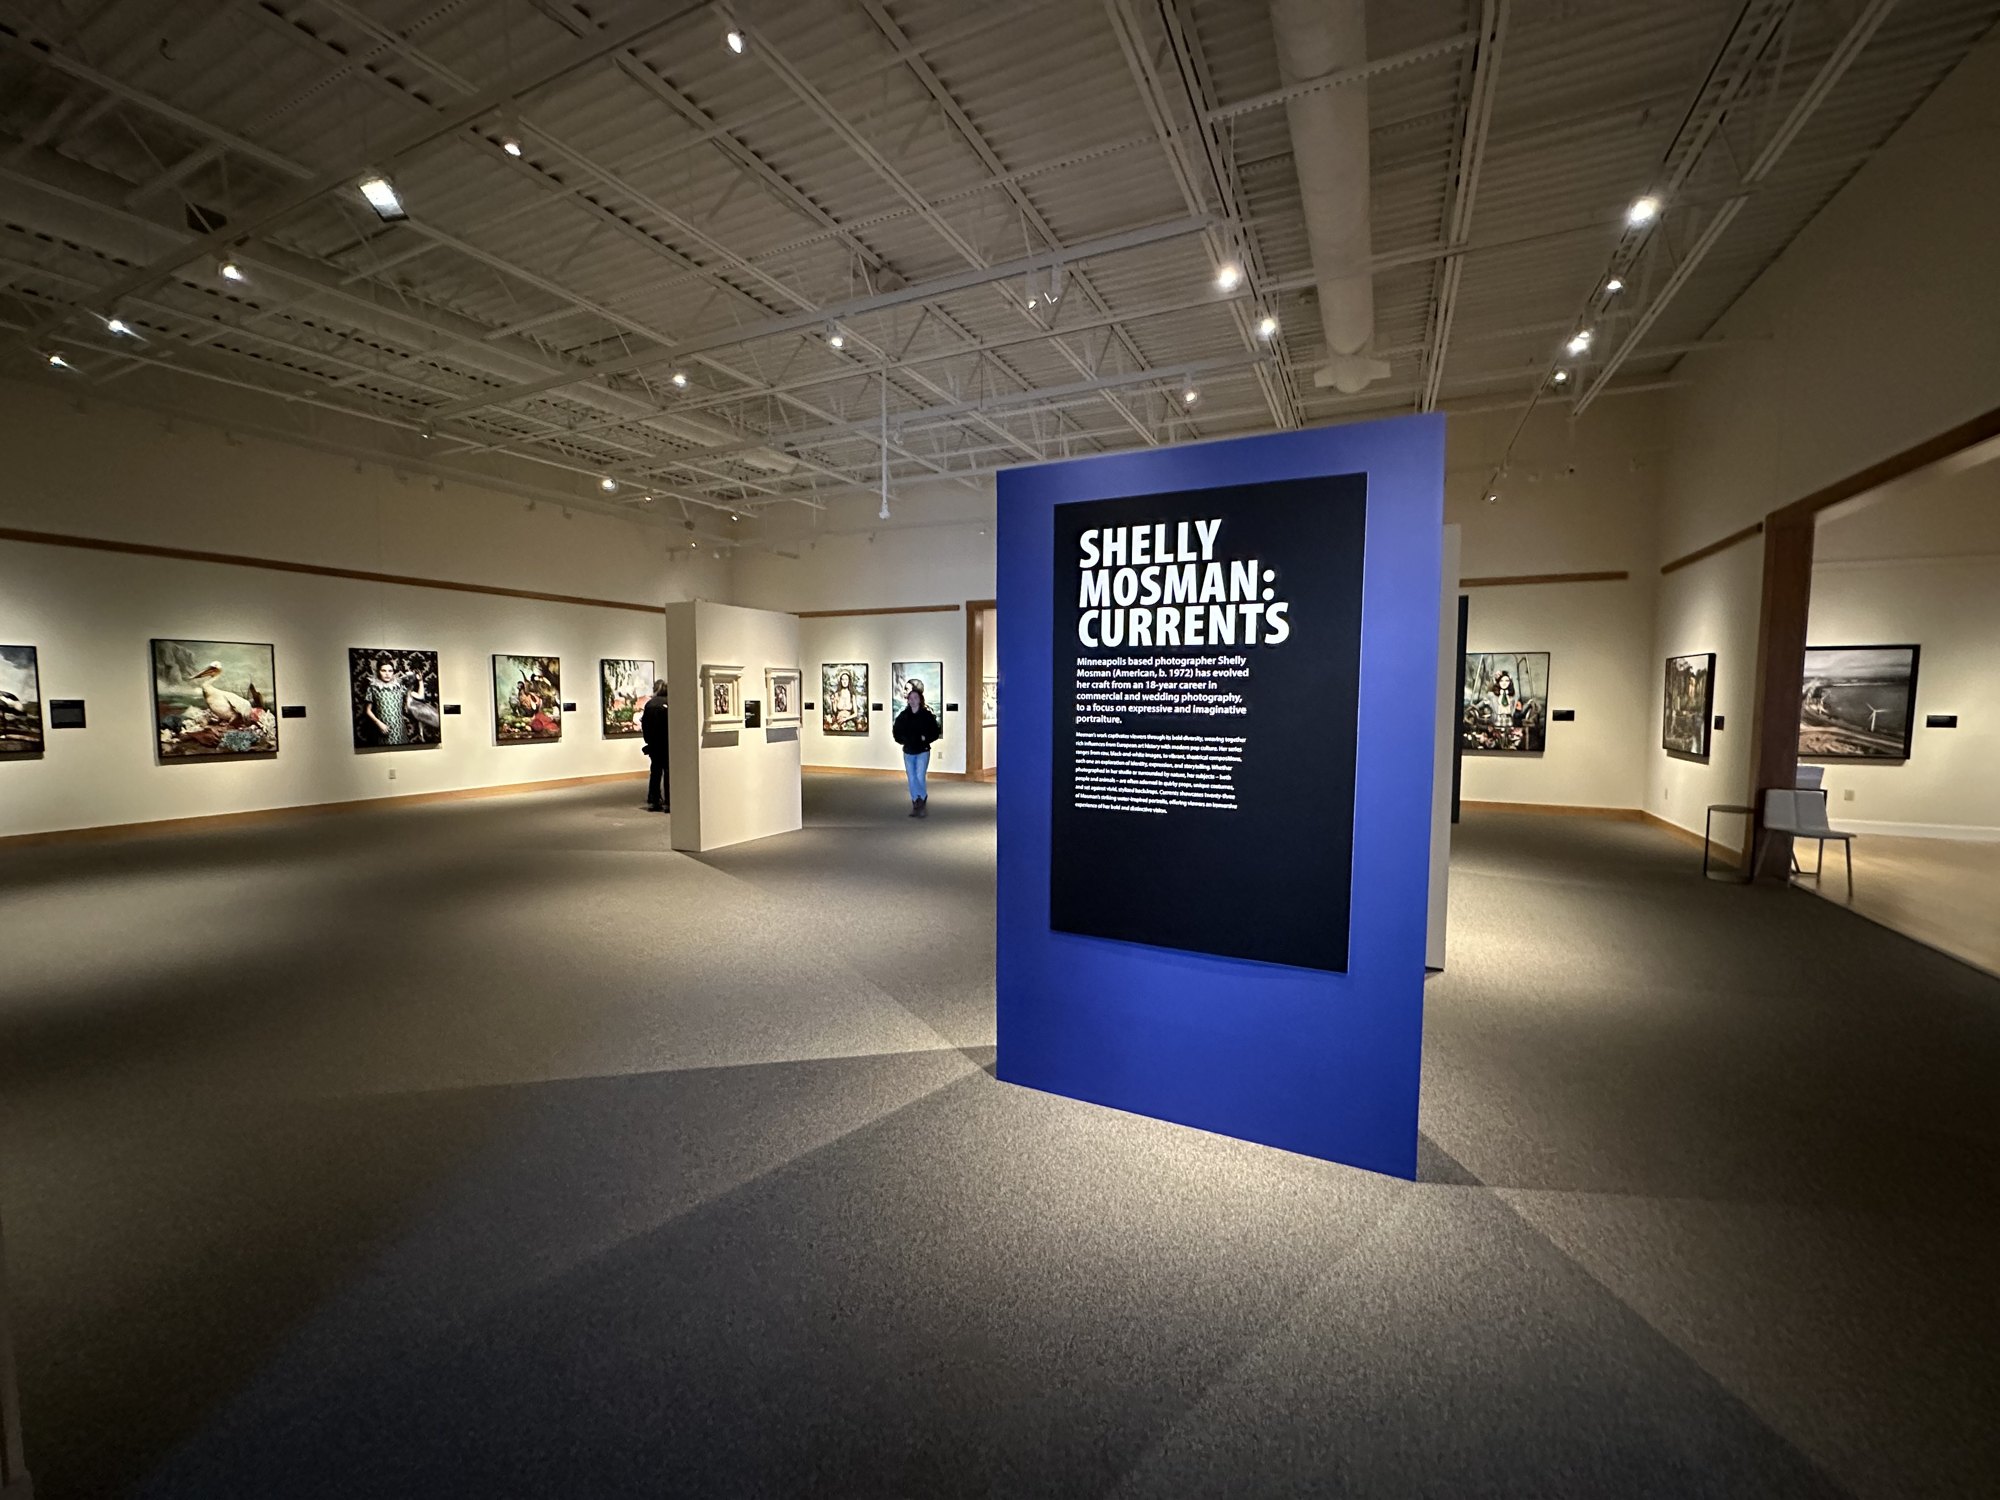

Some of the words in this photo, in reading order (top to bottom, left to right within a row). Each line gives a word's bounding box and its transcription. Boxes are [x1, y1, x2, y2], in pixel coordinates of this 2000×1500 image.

[1080, 519, 1222, 568] SHELLY
[1080, 560, 1275, 607] MOSMAN:
[1079, 602, 1289, 647] CURRENTS
[1077, 657, 1127, 667] Minneapolis
[1128, 656, 1153, 666] based
[1154, 656, 1217, 667] photographer
[1217, 655, 1247, 667] Shelly
[1076, 669, 1111, 677] Mosman
[1112, 669, 1158, 678] (American,
[1158, 668, 1167, 677] b.
[1169, 668, 1194, 678] 1972)
[1195, 668, 1211, 677] has
[1212, 668, 1249, 677] evolved
[1076, 680, 1090, 689] her
[1091, 680, 1110, 689] craft
[1111, 680, 1131, 689] from
[1145, 680, 1178, 691] 18-year
[1208, 680, 1217, 689] in
[1076, 692, 1123, 700] commercial
[1124, 692, 1141, 701] and
[1142, 692, 1180, 703] wedding
[1181, 692, 1243, 704] photography,
[1076, 703, 1085, 711] to
[1092, 703, 1115, 712] focus
[1128, 704, 1173, 714] expressive
[1174, 704, 1191, 713] and
[1192, 703, 1247, 716] imaginative
[1075, 714, 1122, 724] portraiture.
